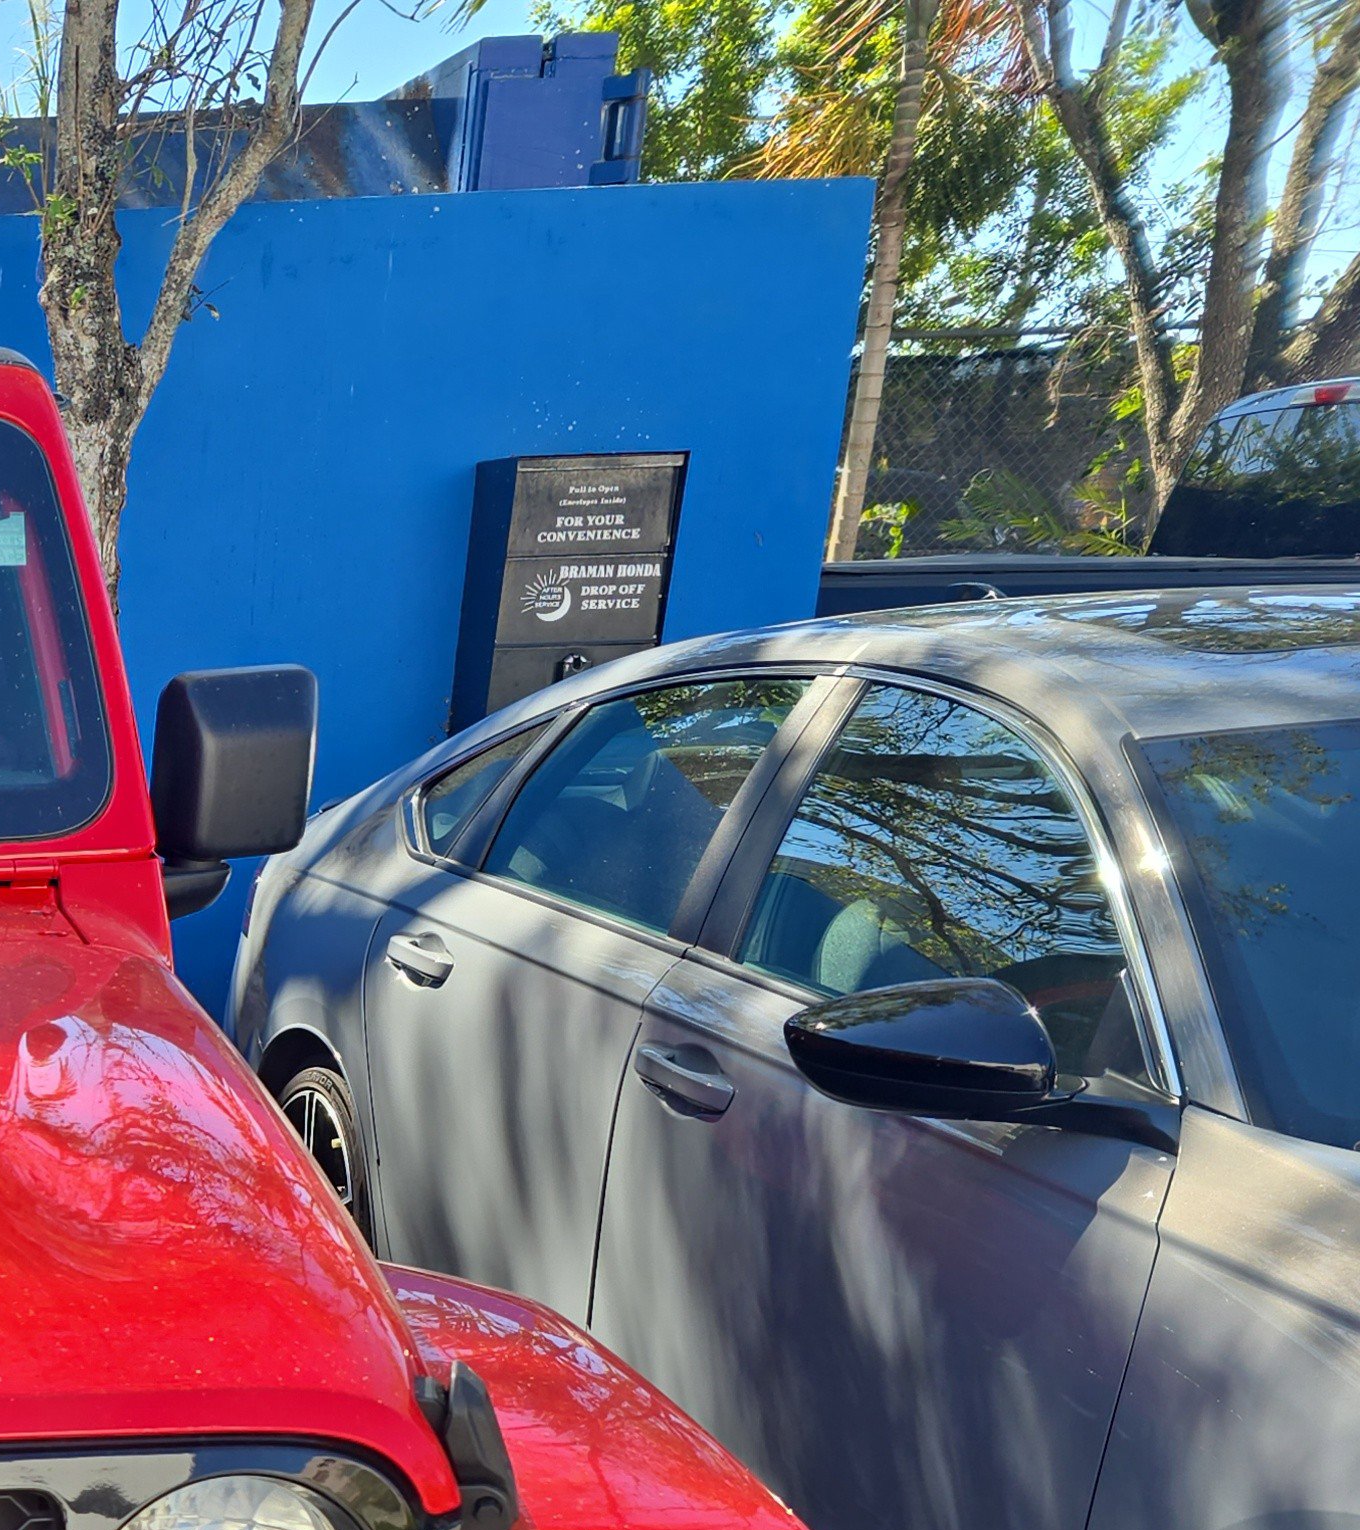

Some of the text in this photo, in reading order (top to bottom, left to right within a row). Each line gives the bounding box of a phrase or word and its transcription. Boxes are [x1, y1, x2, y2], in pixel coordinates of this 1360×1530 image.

[598, 485, 620, 495] Open
[556, 514, 625, 527] FOR YOUR
[537, 528, 641, 543] CONVENIENCE
[560, 564, 662, 579] BRAMAN HONDA
[580, 583, 646, 596] DROP OFF
[580, 598, 641, 611] SERVICE
